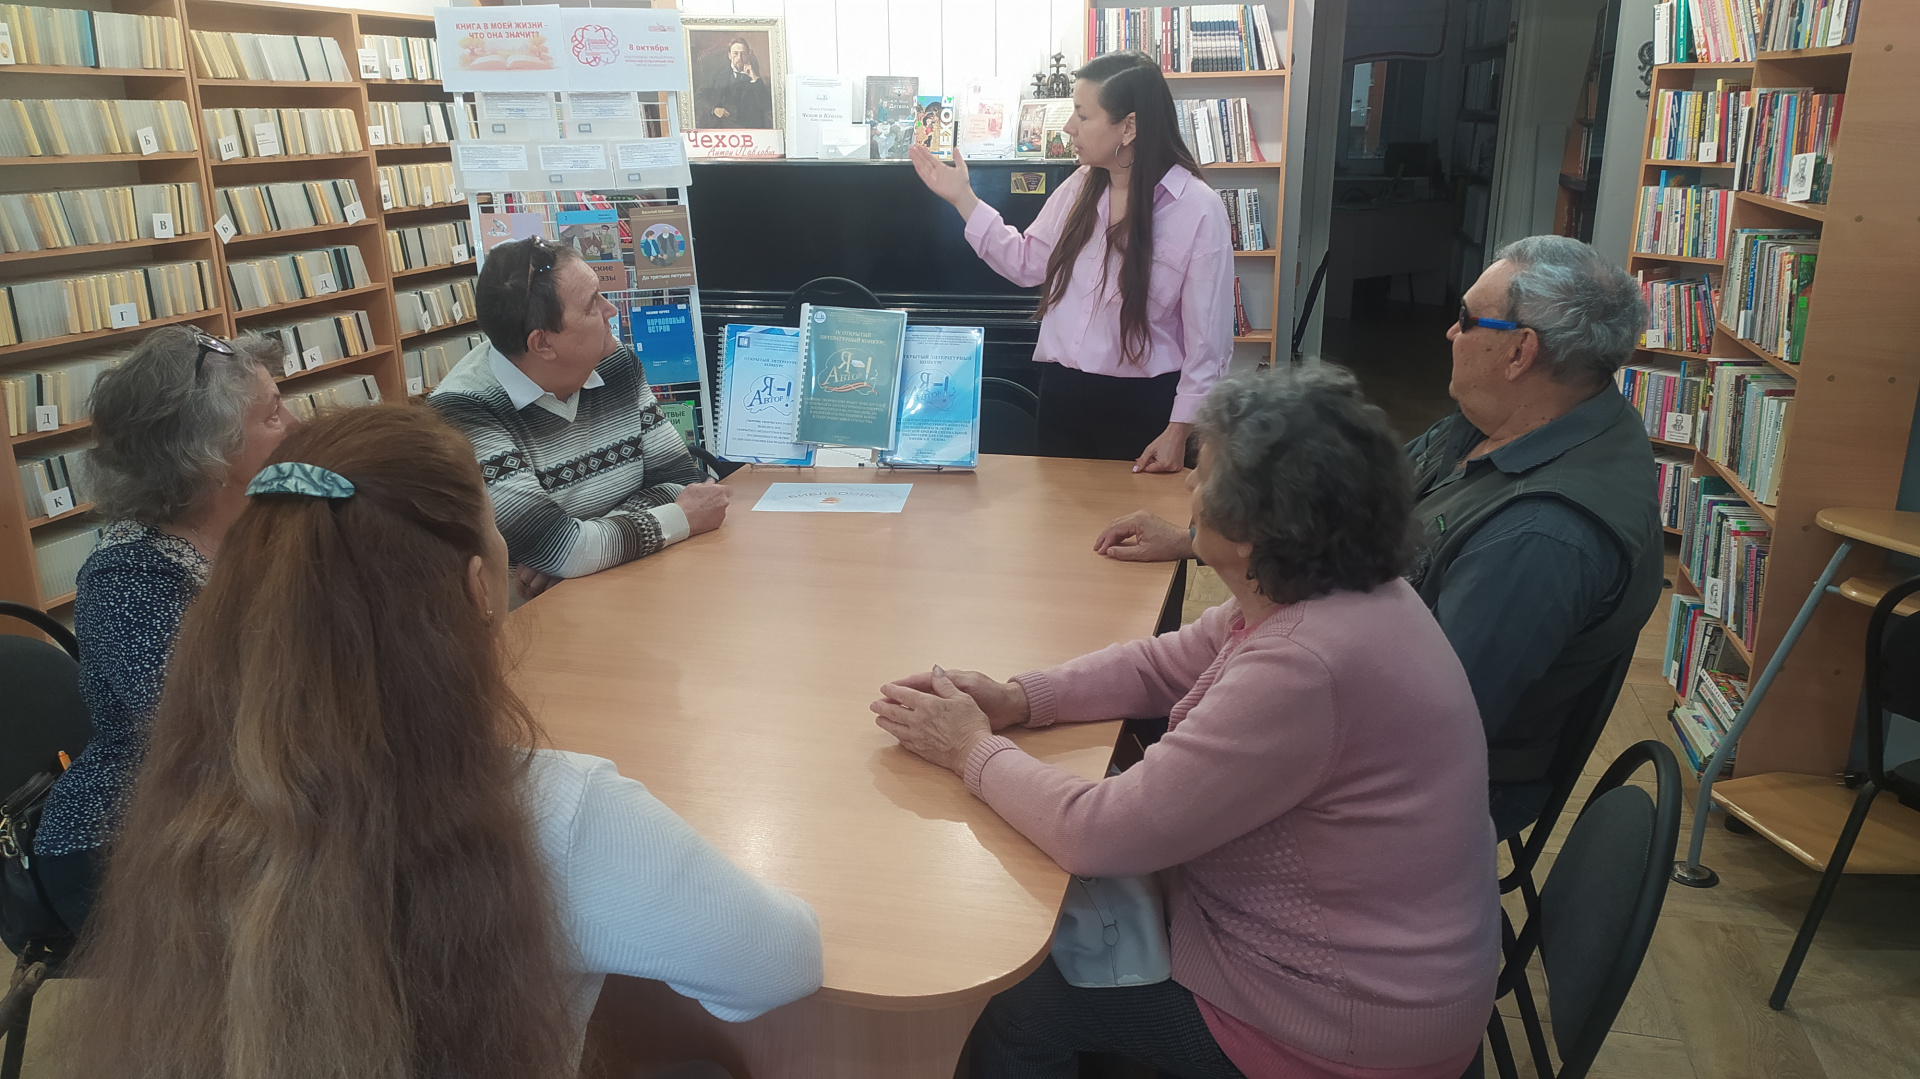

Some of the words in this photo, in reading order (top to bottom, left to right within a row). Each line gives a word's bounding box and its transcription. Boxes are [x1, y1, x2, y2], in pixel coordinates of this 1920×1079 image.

[490, 21, 513, 29] МОЕЙ
[636, 44, 669, 52] октября
[143, 134, 151, 146] Б
[373, 131, 380, 139] К
[686, 130, 754, 148] Чехов
[224, 142, 234, 153] Ш
[708, 145, 733, 156] Антон
[160, 220, 167, 230] В
[456, 250, 463, 258] К
[320, 279, 330, 290] Д
[119, 311, 128, 322] Г
[648, 325, 670, 333] ОСТРОВ
[309, 352, 318, 363] К
[42, 413, 51, 425] Д
[53, 496, 65, 508] К
